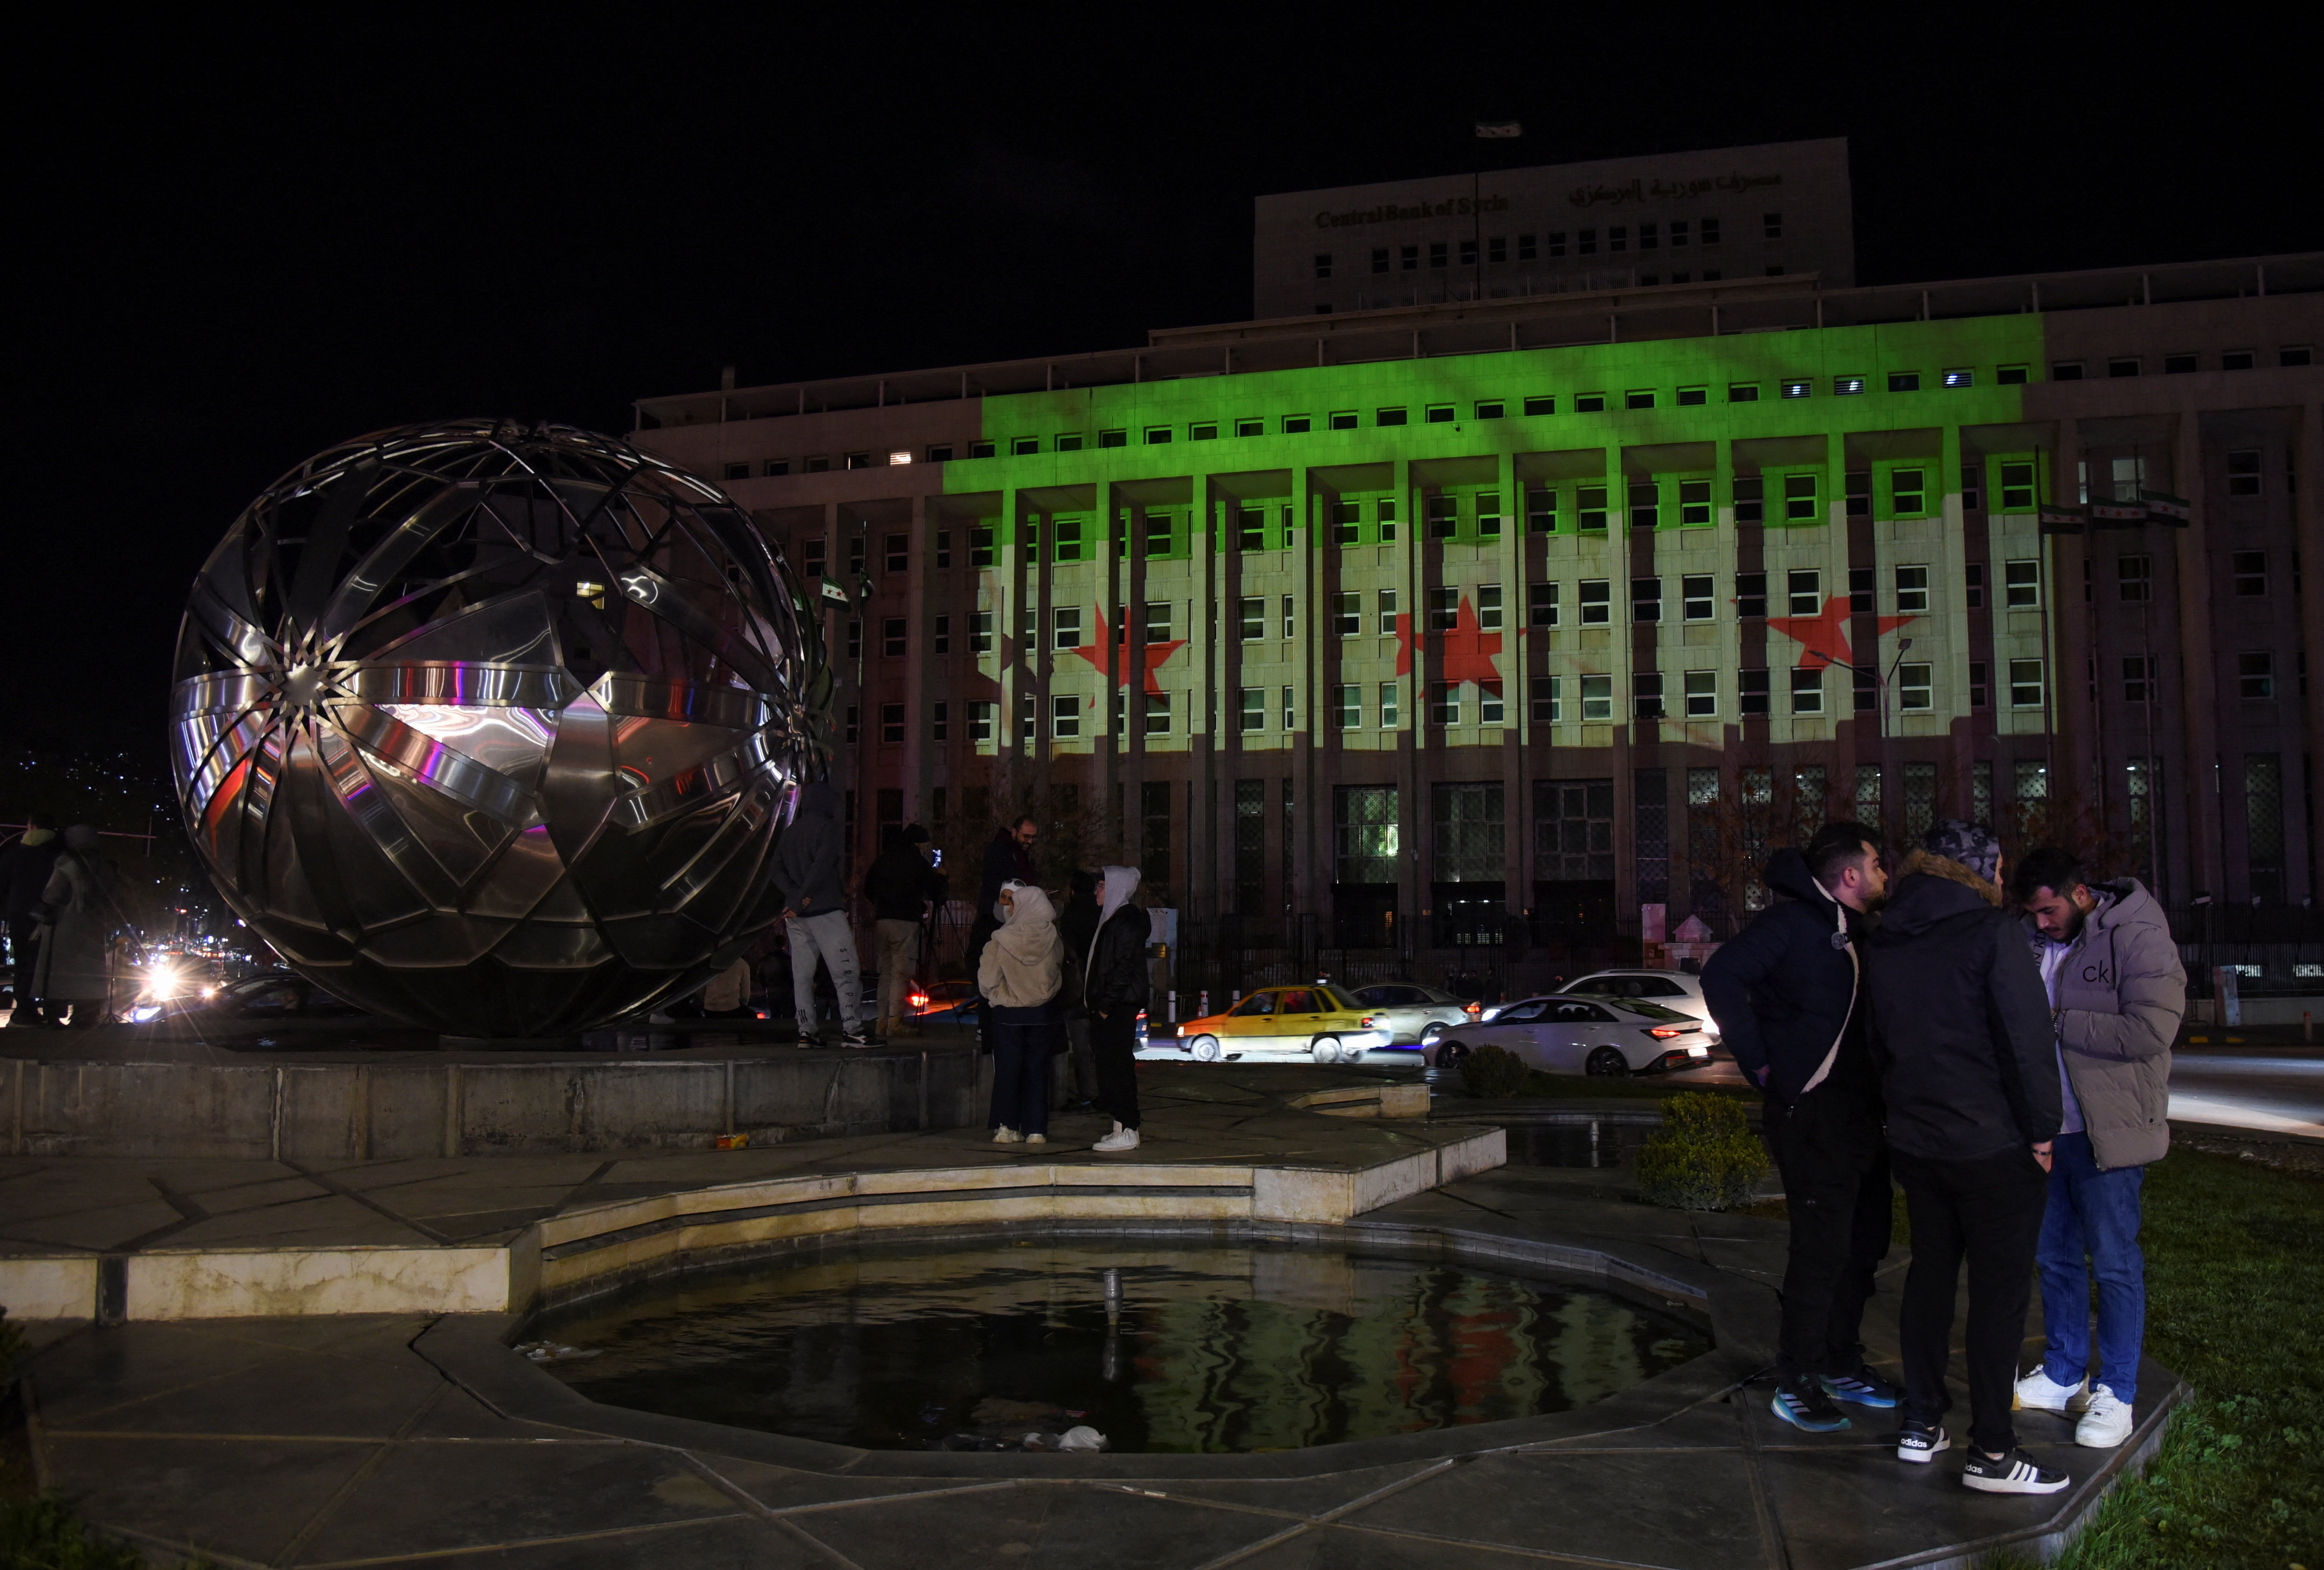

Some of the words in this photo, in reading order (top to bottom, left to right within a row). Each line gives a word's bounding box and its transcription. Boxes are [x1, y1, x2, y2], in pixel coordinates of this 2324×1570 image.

[1315, 206, 1382, 229] Central
[1386, 202, 1433, 221] Bank
[1435, 199, 1454, 216] of
[839, 947, 855, 1020] STRIPES
[2083, 960, 2109, 983] ck
[1901, 1438, 1928, 1448] adidas
